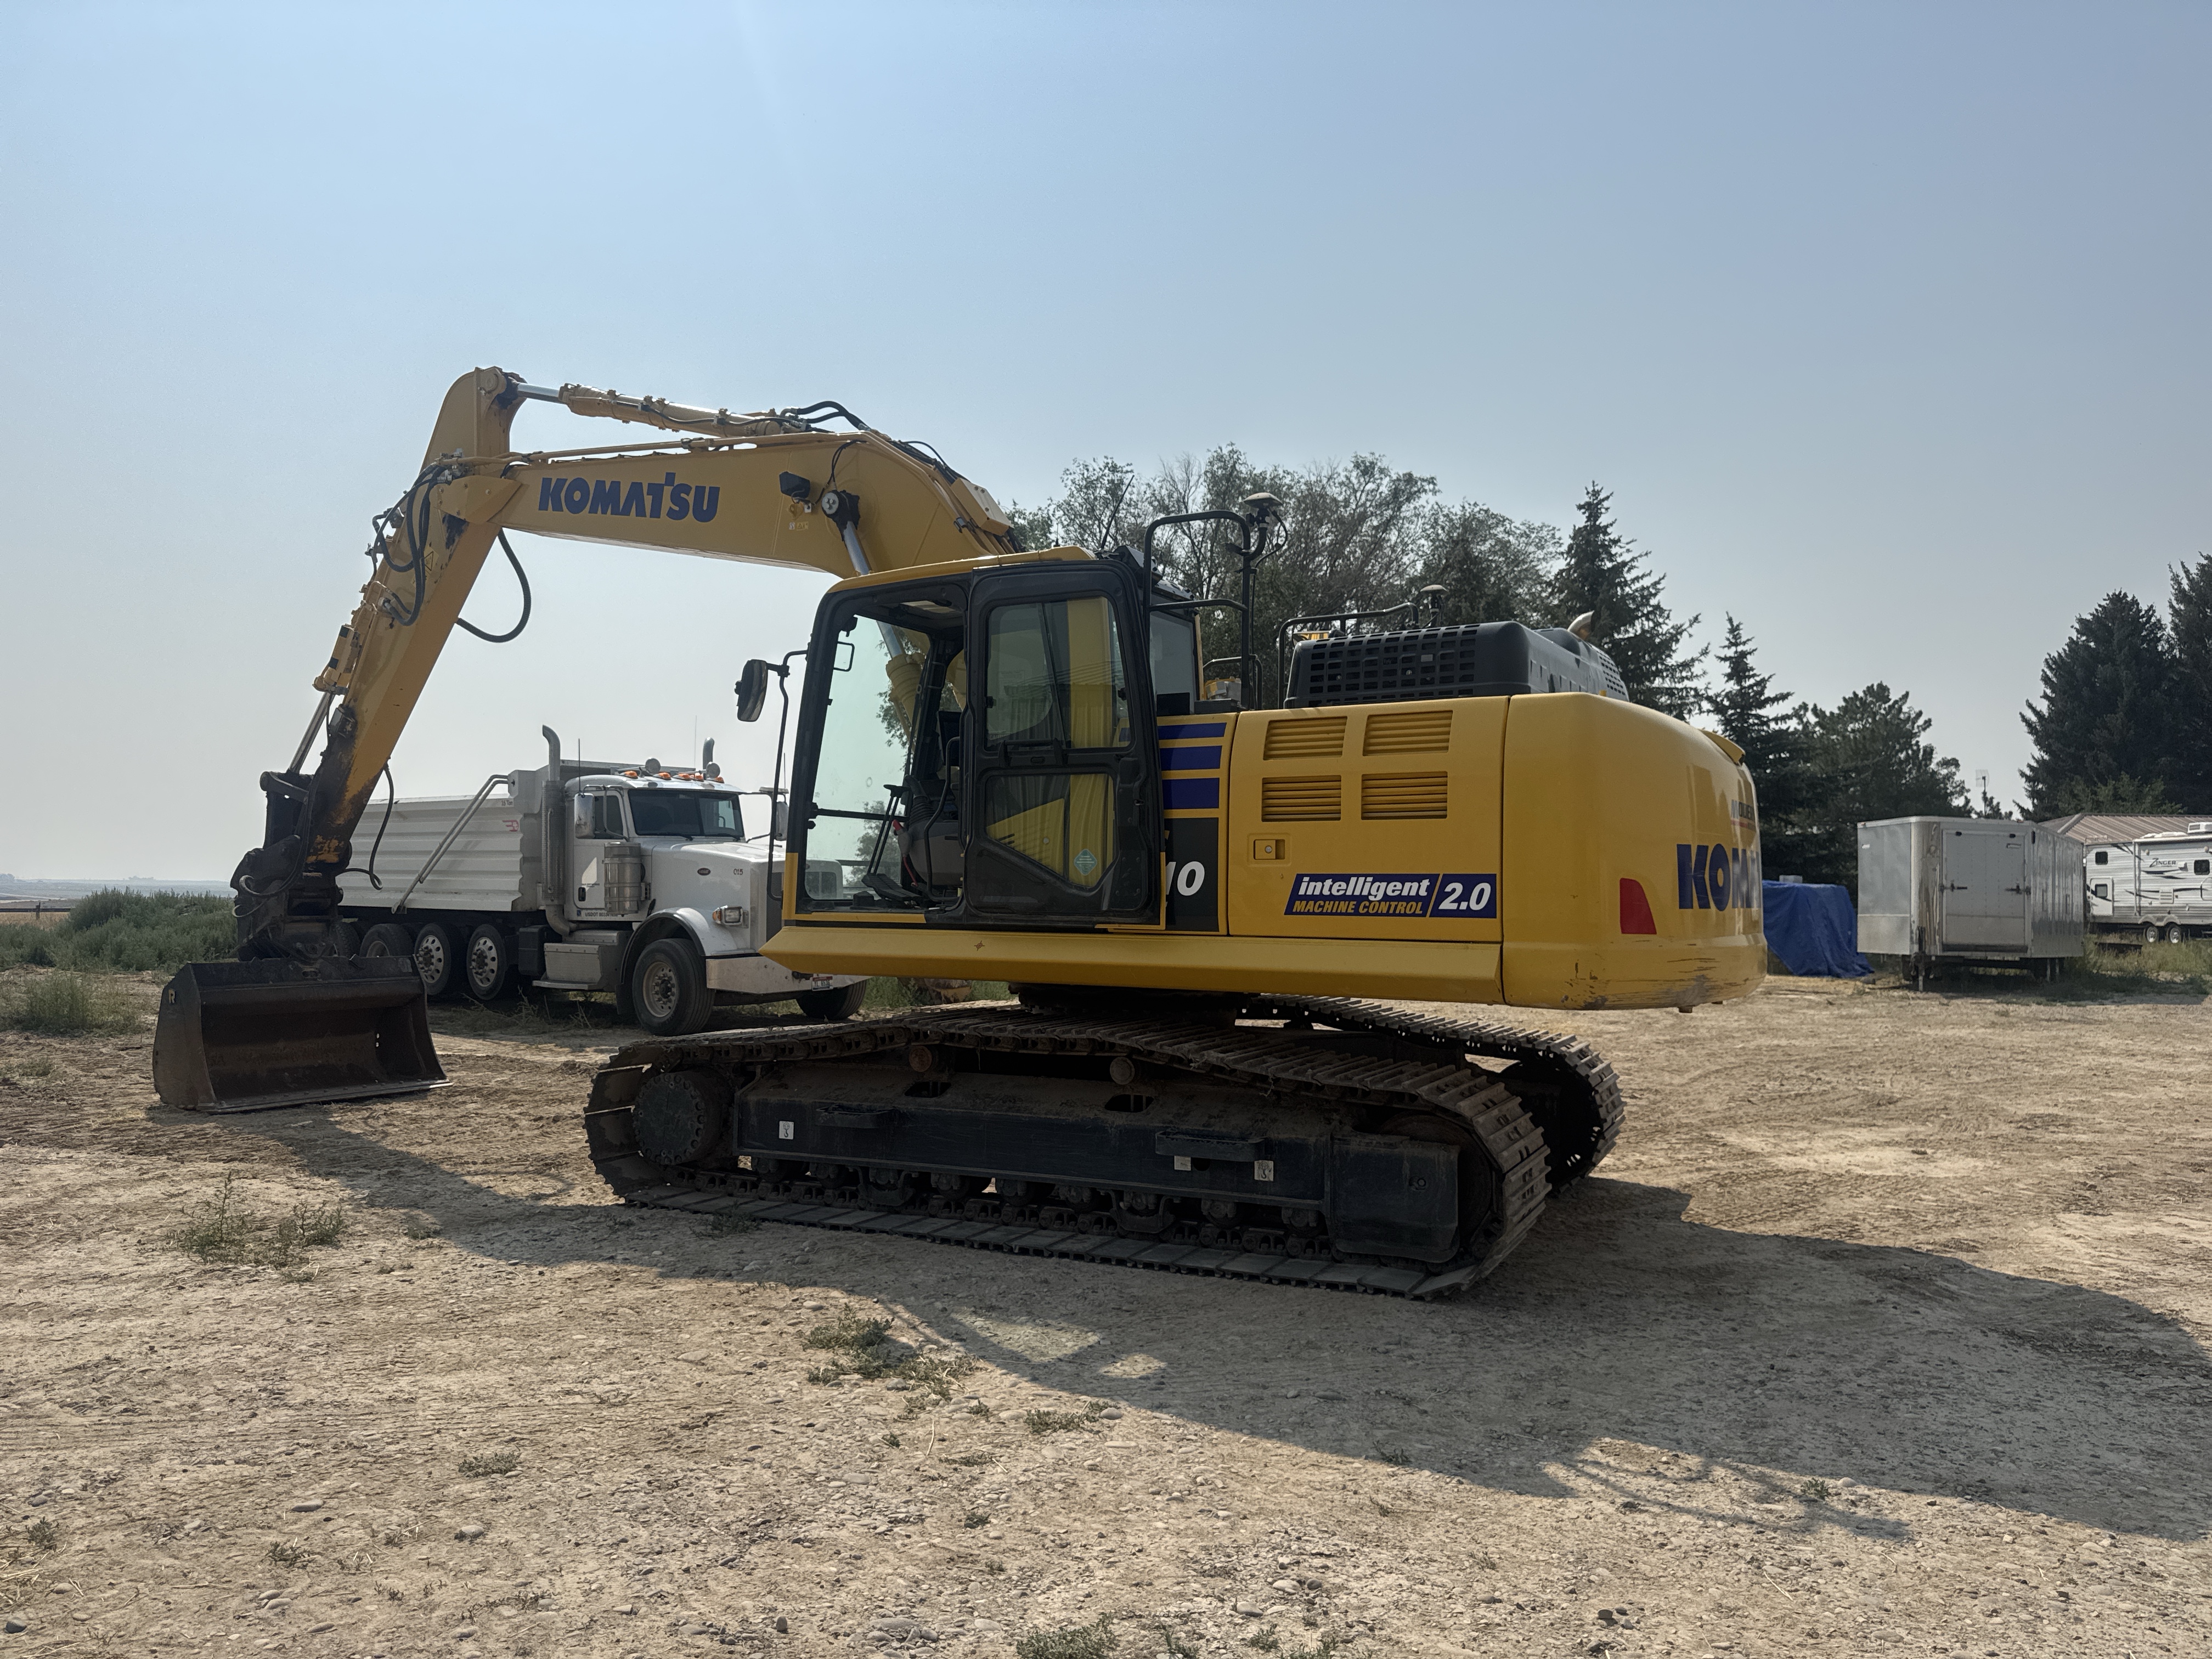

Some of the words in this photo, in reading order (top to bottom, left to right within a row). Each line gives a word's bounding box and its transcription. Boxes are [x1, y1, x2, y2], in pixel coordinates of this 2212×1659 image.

[538, 472, 720, 523] KOMATSU
[1165, 861, 1205, 896] 10
[1298, 876, 1430, 901] intelligent
[1293, 900, 1356, 913] MACHINE
[1358, 901, 1423, 915] CONTROL
[1437, 882, 1491, 911] 2.0
